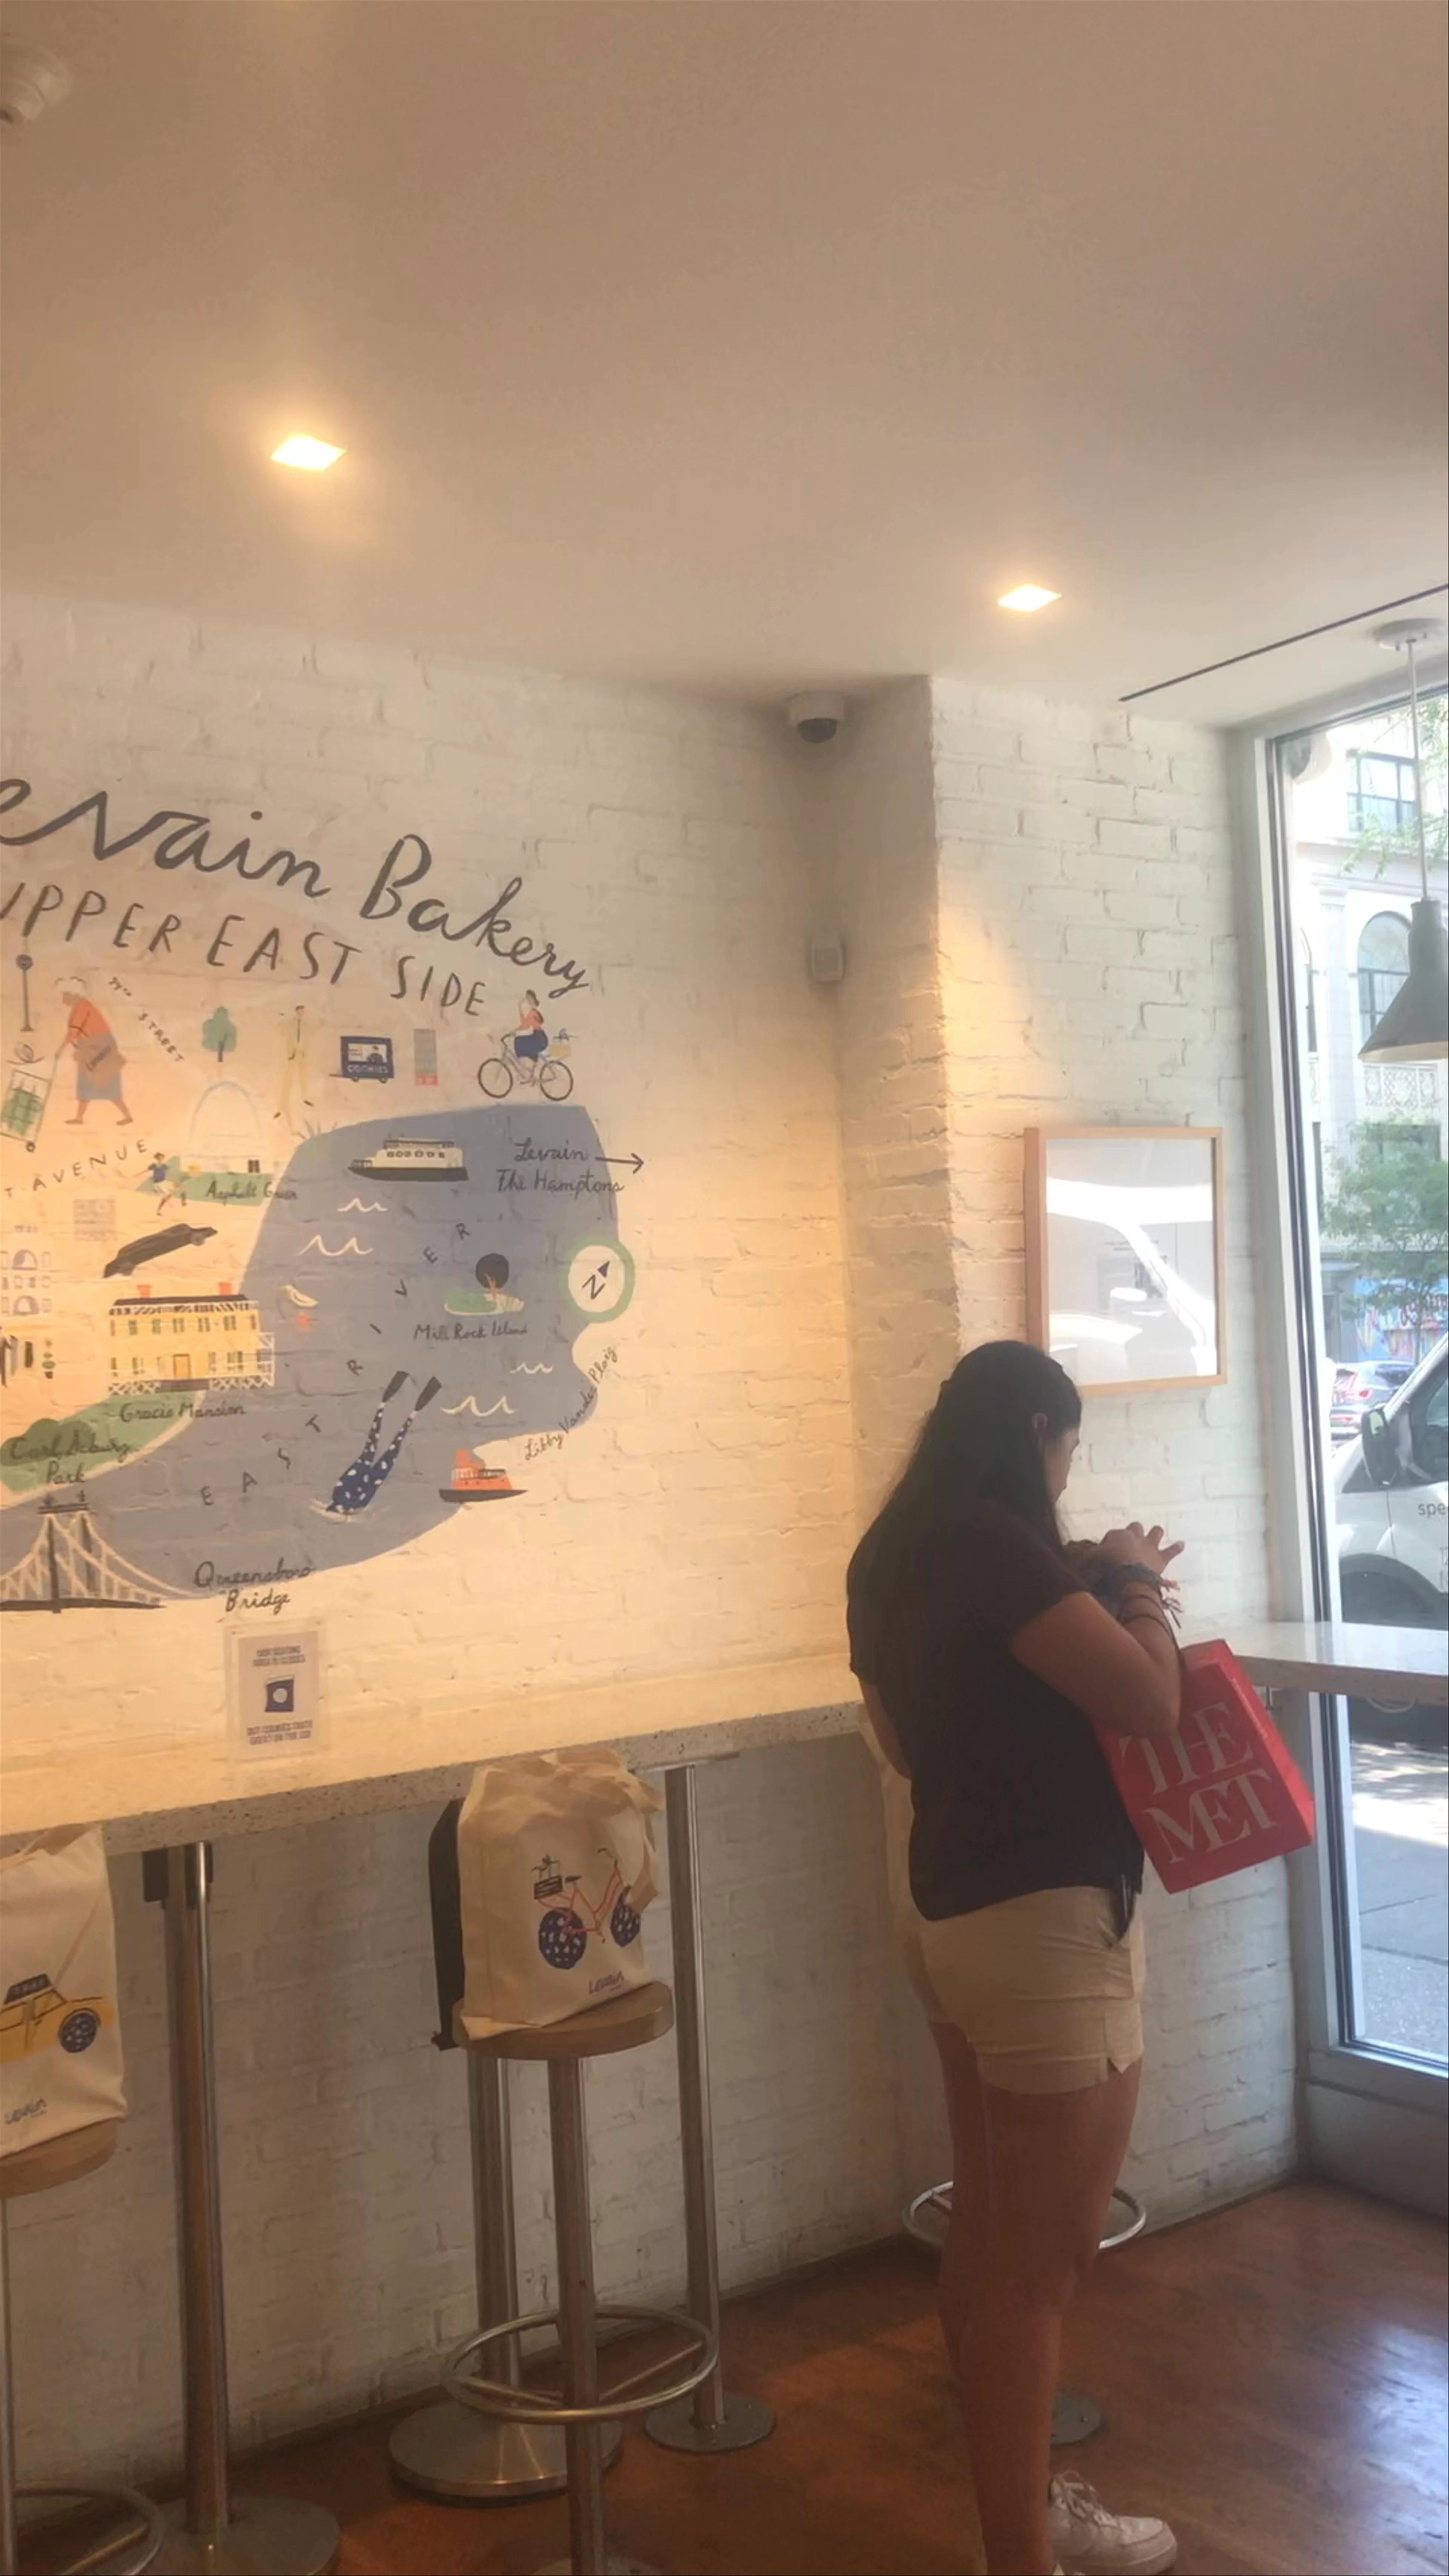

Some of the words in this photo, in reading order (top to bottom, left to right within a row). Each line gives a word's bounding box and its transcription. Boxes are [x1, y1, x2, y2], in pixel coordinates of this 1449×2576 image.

[360, 834, 589, 998] Bakery
[207, 915, 362, 985] EAST
[390, 956, 486, 1016] SIDE
[138, 1012, 185, 1062] STREET
[33, 1139, 148, 1192] AVENUE
[514, 1137, 589, 1162] Levain
[496, 1169, 527, 1192] The
[534, 1169, 625, 1201] Hamptons
[413, 1324, 451, 1341] Mill
[454, 1322, 488, 1340] Rock
[46, 1459, 86, 1486] Park
[225, 1587, 291, 1615] Bridge
[1119, 1701, 1254, 1795] THE
[1142, 1769, 1278, 1865] MET
